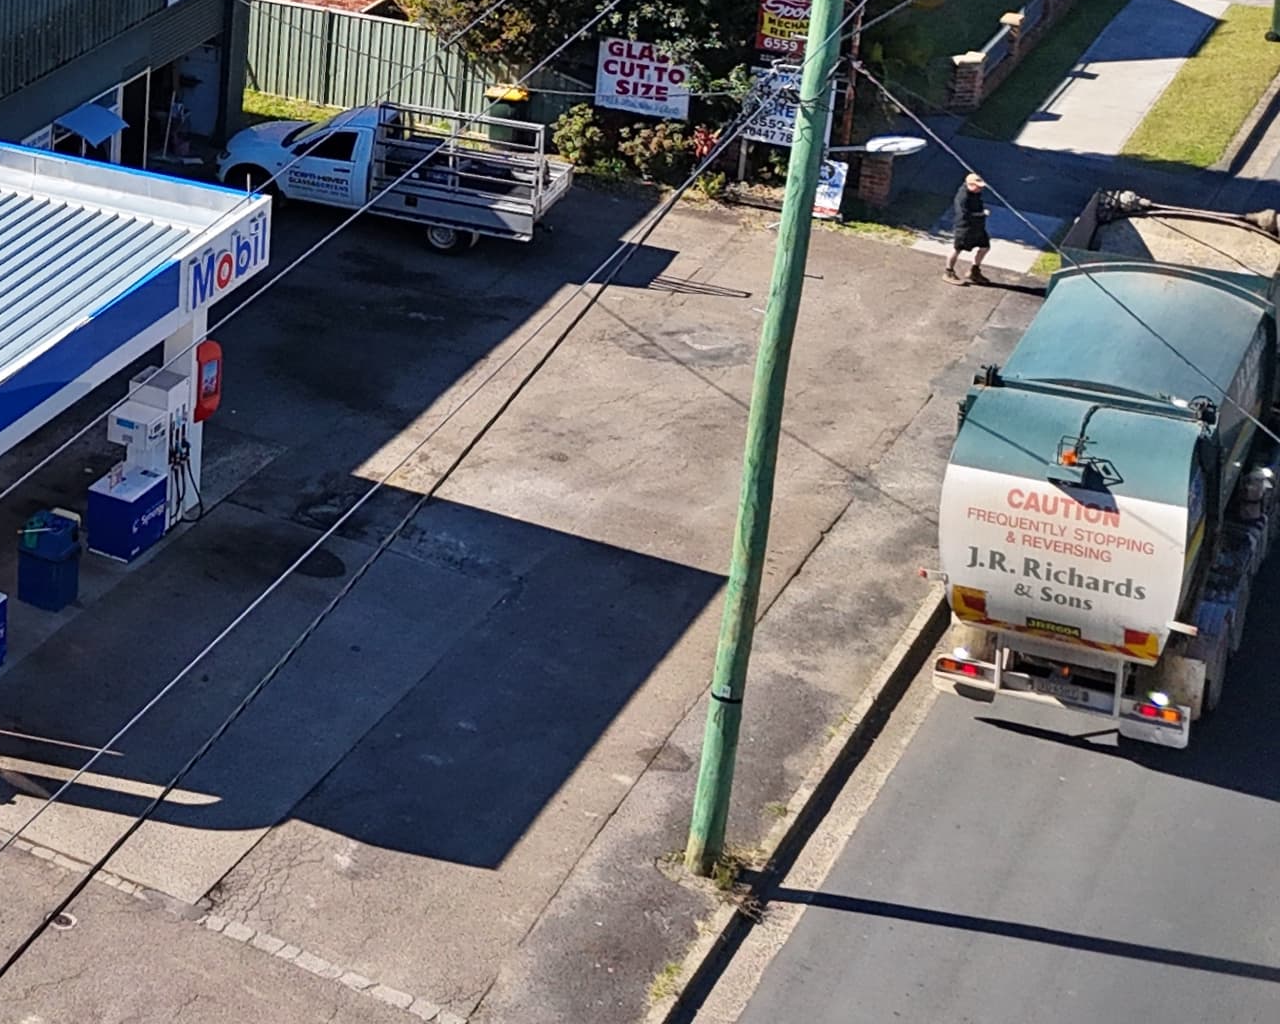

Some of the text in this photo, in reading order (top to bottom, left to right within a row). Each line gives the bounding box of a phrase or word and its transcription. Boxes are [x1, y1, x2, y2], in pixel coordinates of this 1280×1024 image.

[763, 37, 798, 51] 6559
[603, 59, 685, 84] CUT TO
[615, 79, 668, 102] SIZE
[192, 216, 267, 310] Mobil
[1007, 488, 1121, 528] CAUTION
[967, 507, 1155, 556] FREQUENTLY STOPPING
[1006, 531, 1113, 563] & REVERSING
[967, 546, 1147, 601] J.R. Richards
[1014, 583, 1093, 611] & Sons
